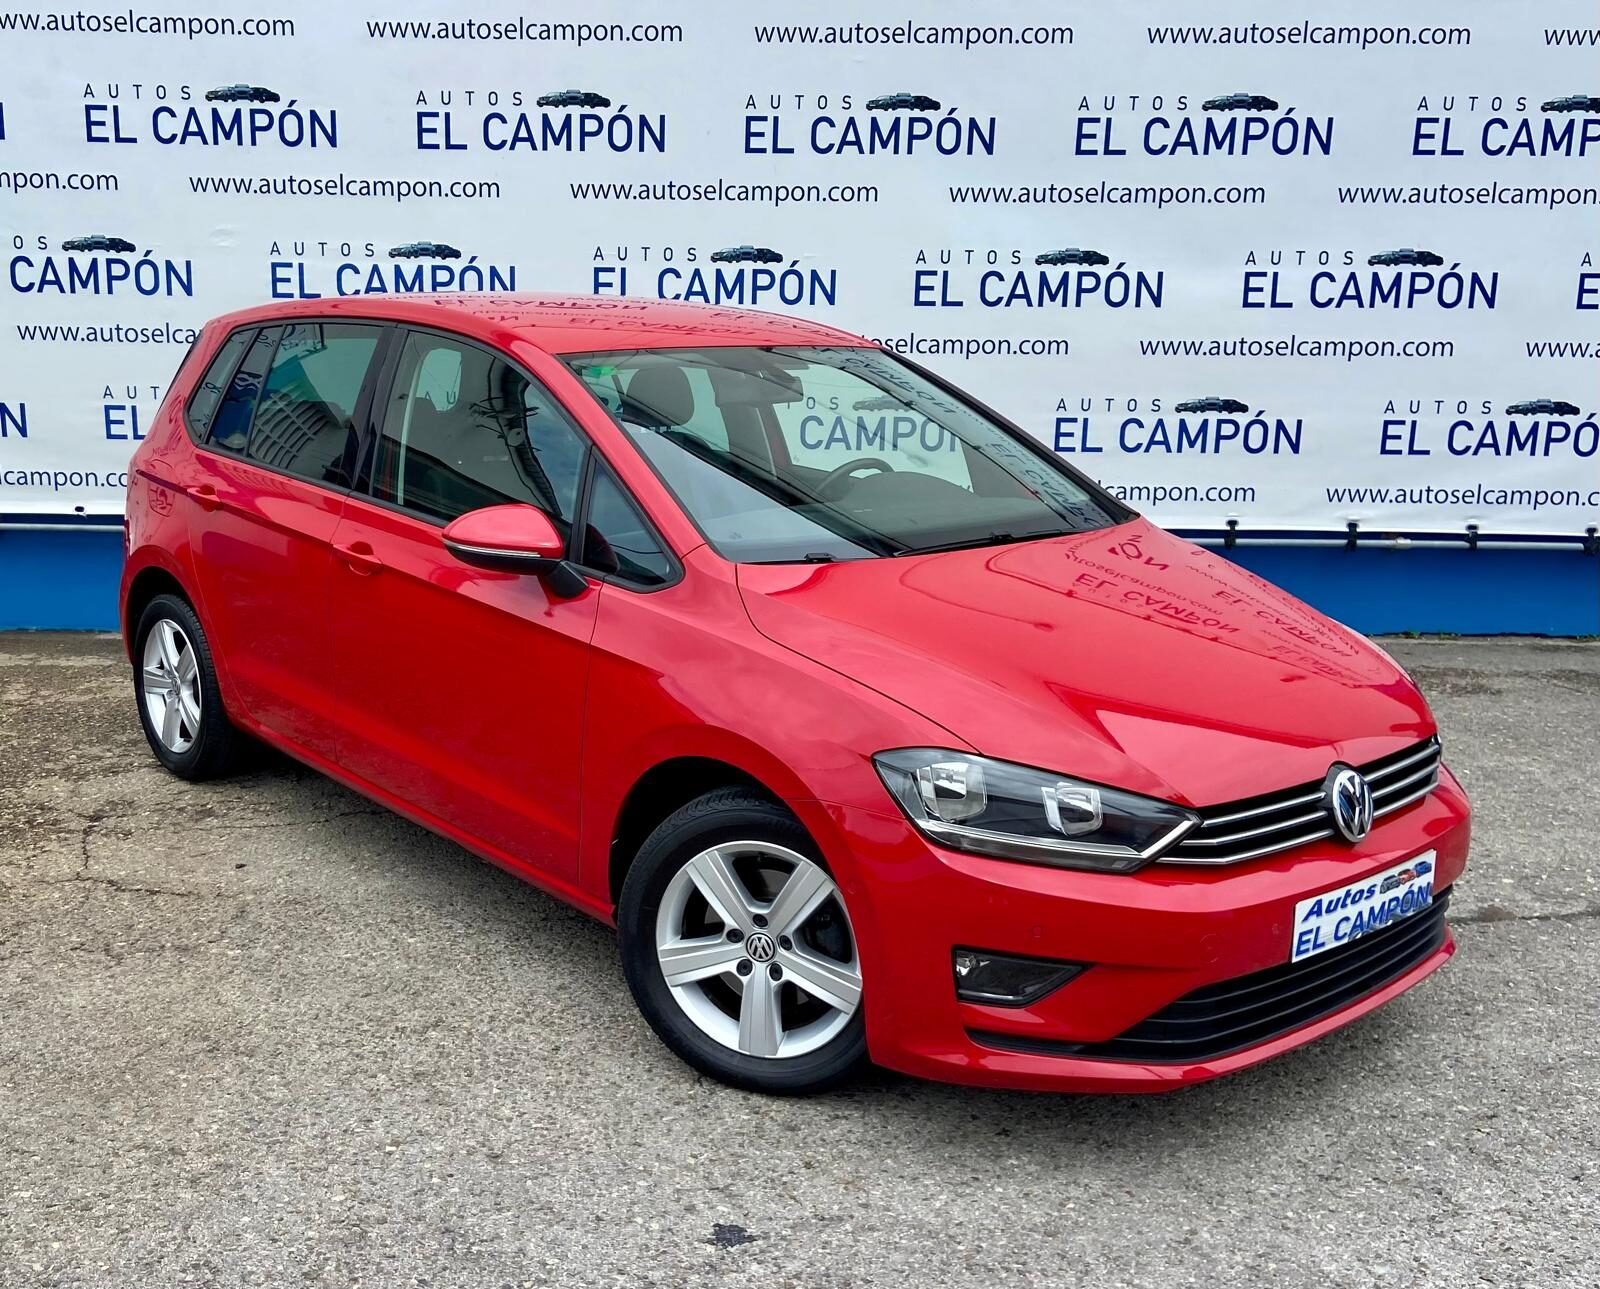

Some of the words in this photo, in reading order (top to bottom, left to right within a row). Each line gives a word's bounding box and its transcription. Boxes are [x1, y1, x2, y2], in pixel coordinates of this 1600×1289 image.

[367, 17, 682, 46] www.autoselcampon.com
[755, 20, 1073, 50] www.autoselcampon.com
[1148, 21, 1470, 49] www.autoselcampon.com
[84, 84, 190, 100] AUTOS
[417, 91, 522, 106] AUTOS
[746, 95, 851, 110] AUTOS
[1078, 96, 1187, 110] AUTOS
[1417, 96, 1526, 111] AUTOS
[85, 105, 137, 143] EL
[153, 100, 337, 147] CAMPÓN
[417, 112, 467, 150] EL
[483, 105, 665, 152] CAMPÓN
[745, 116, 794, 153] EL
[811, 108, 995, 155] CAMPÓN
[1075, 118, 1126, 155] EL
[1144, 108, 1333, 155] CAMPÓN
[1413, 118, 1464, 155] EL
[1482, 118, 1600, 156] CAMP
[190, 174, 499, 202] www.autoselcampon.com
[570, 179, 877, 206] www.autoselcampon.com
[950, 181, 1264, 208] www.autoselcampon.com
[1339, 182, 1600, 209] www.autoselcampon
[271, 242, 374, 257] AUTOS
[594, 247, 696, 261] AUTOS
[916, 250, 1020, 264] AUTOS
[1245, 251, 1353, 265] AUTOS
[10, 250, 192, 296] CAMPÓN
[271, 262, 321, 299] EL
[337, 256, 515, 296] CAMPÓN
[658, 260, 836, 305] CAMPÓN
[914, 270, 963, 306] EL
[980, 262, 1163, 308] CAMPÓN
[1242, 272, 1293, 308] EL
[1310, 263, 1498, 309] CAMPÓN
[1140, 335, 1453, 361] www.autoselcampon.com
[1056, 398, 1160, 412] AUTOS
[1384, 400, 1491, 414] AUTOS
[104, 405, 146, 440] EL
[1054, 418, 1103, 453] EL
[1120, 410, 1302, 454] CAMPÓN
[1380, 420, 1430, 455] EL
[1302, 883, 1378, 923] Autos
[1295, 925, 1326, 958] EL
[1333, 880, 1433, 943] CAMPÓN
